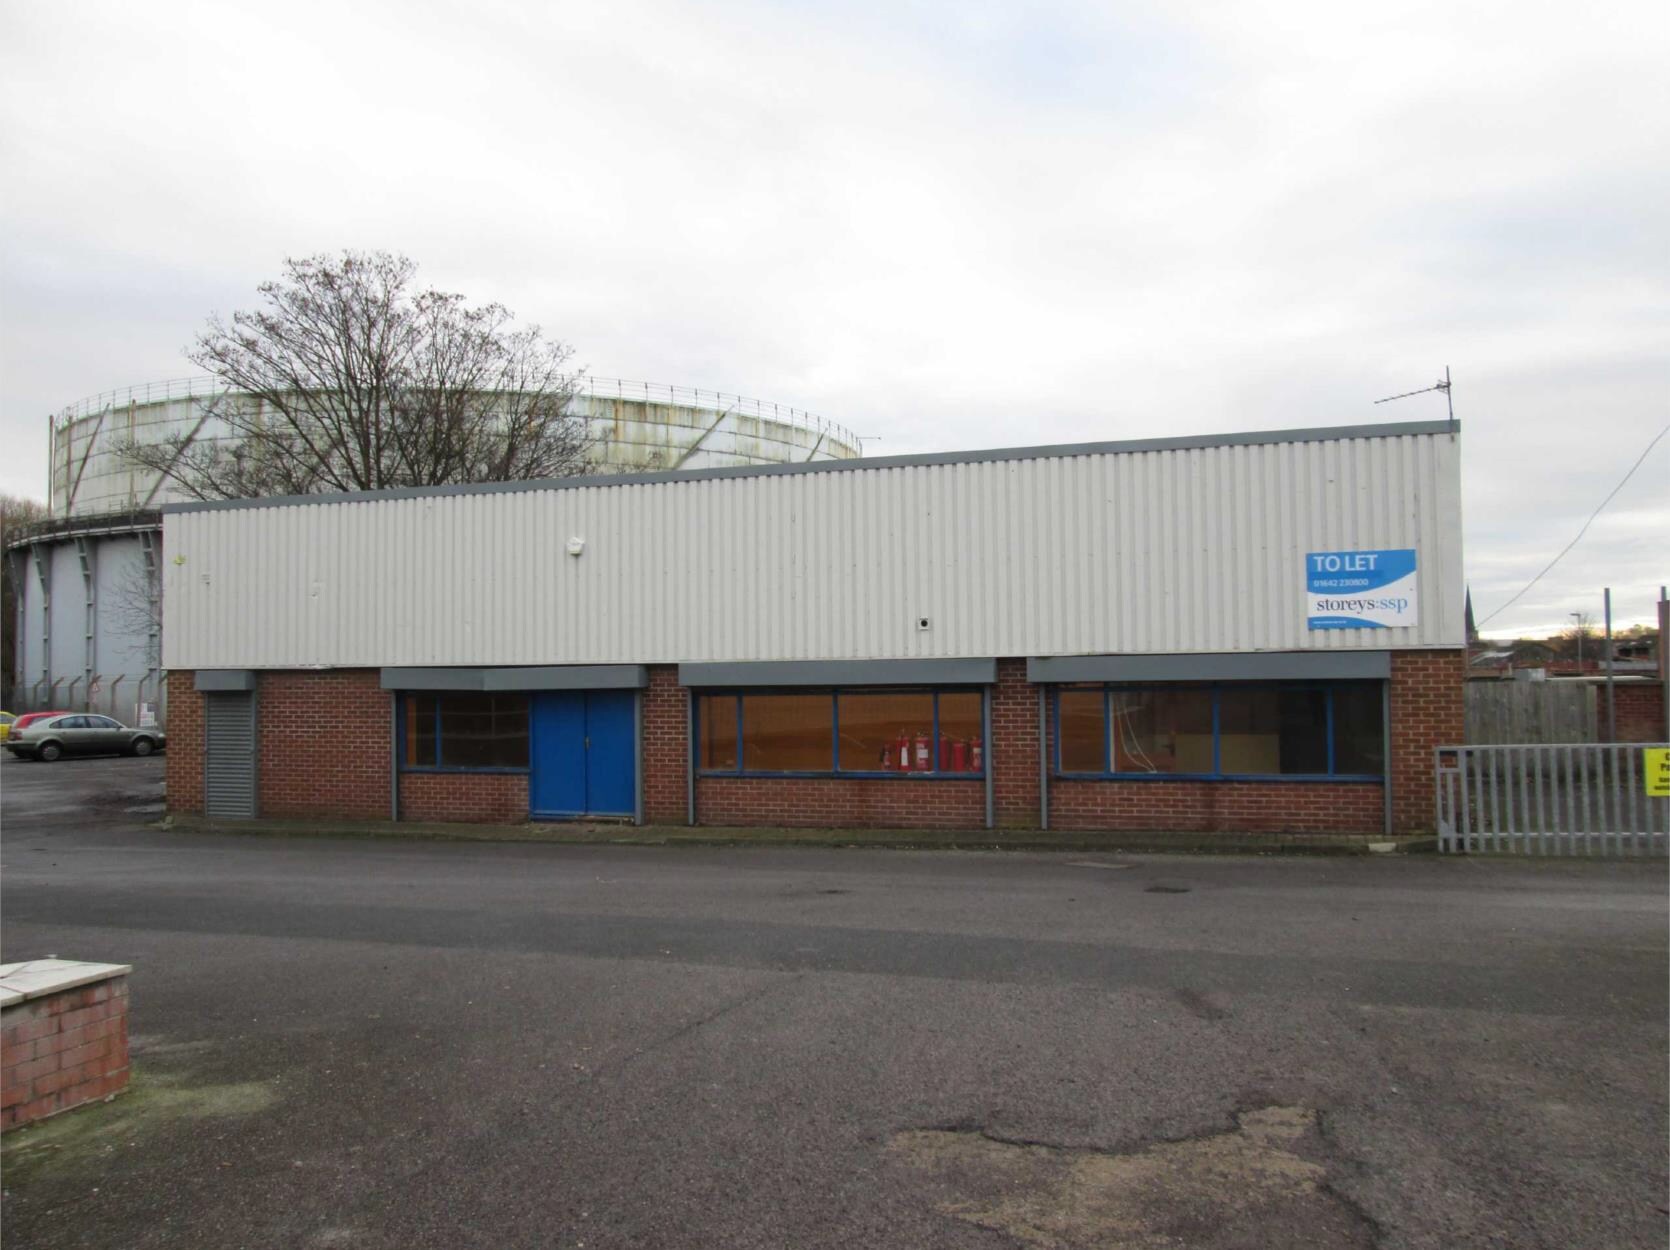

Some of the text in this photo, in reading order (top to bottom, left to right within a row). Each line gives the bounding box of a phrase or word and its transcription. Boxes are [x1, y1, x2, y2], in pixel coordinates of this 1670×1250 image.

[1313, 554, 1378, 572] TO LET
[1313, 579, 1338, 587] 01642
[1316, 598, 1408, 614] storeys:ssp
